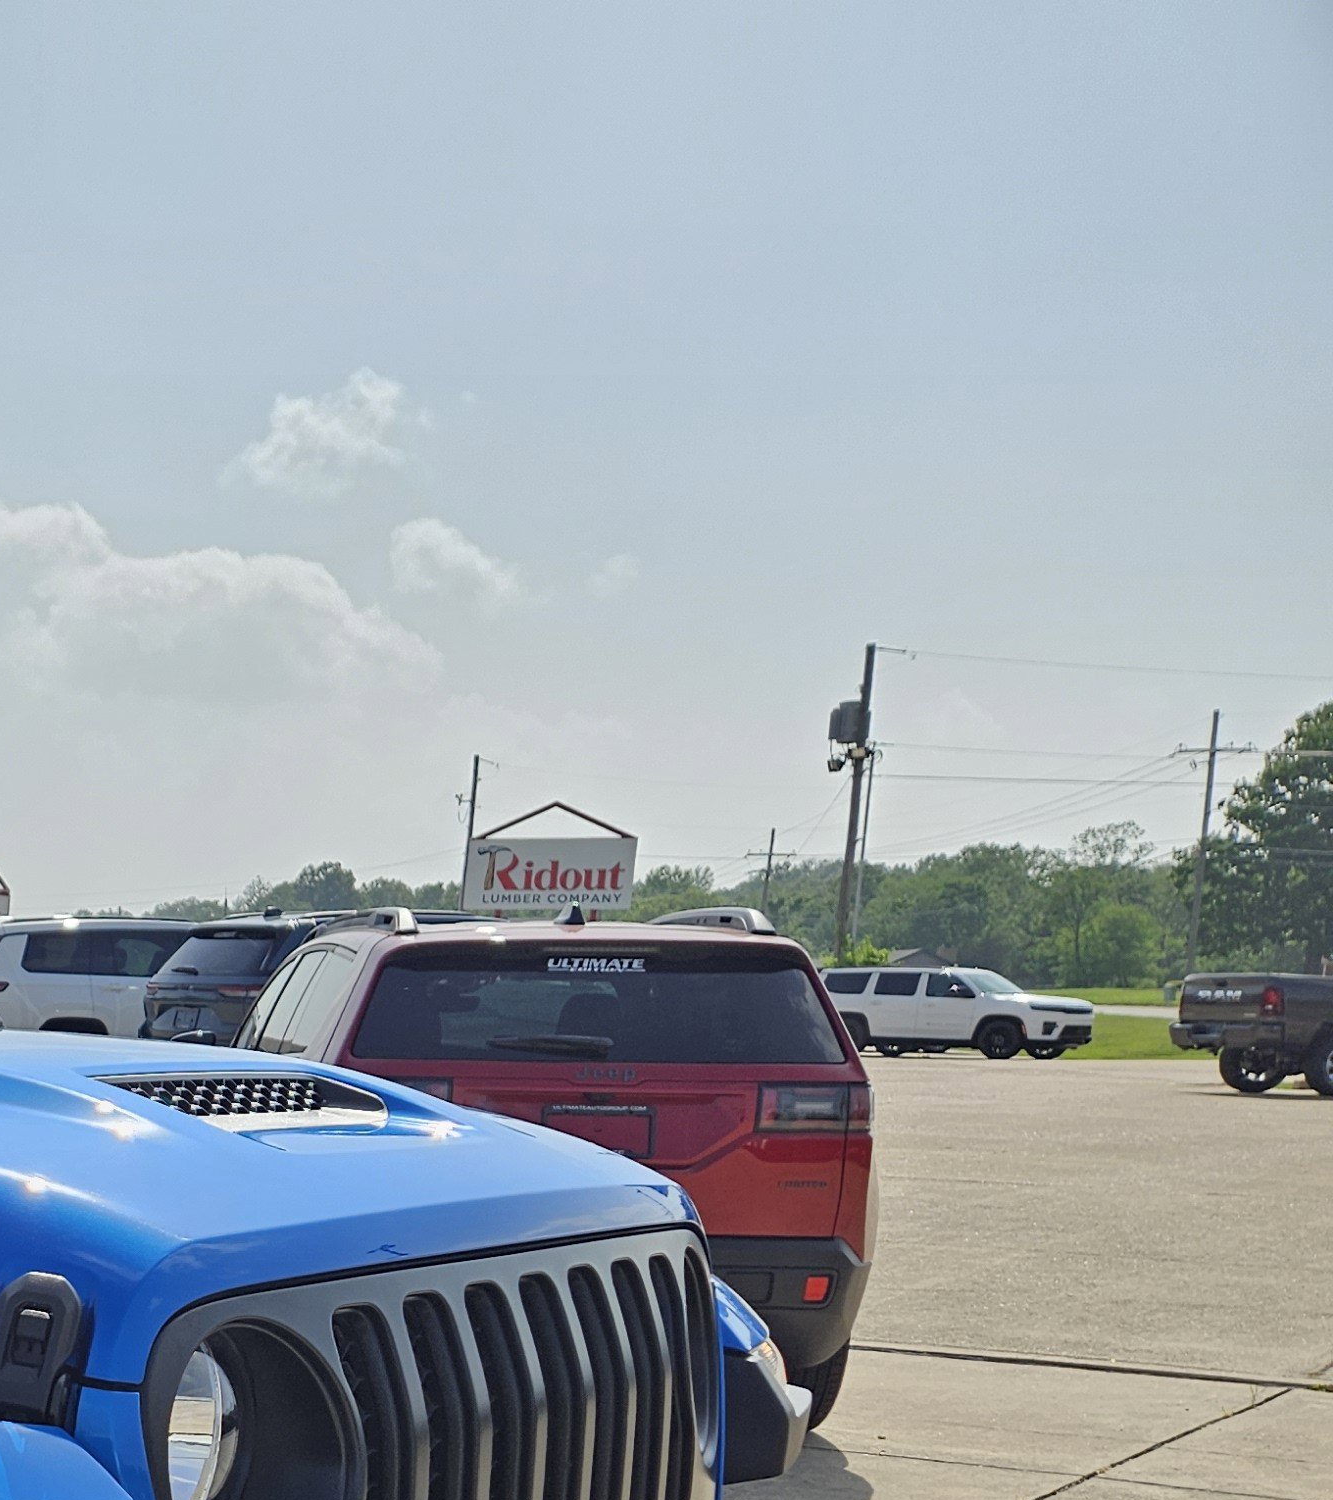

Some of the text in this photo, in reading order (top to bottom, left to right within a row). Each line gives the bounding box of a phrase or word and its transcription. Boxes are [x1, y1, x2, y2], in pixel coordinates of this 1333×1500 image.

[478, 844, 626, 891] Ridout
[482, 892, 623, 904] LUMBER COMPANY
[547, 957, 646, 969] ULTIMATE
[1197, 989, 1243, 1002] RAM
[575, 1066, 637, 1082] Jeep
